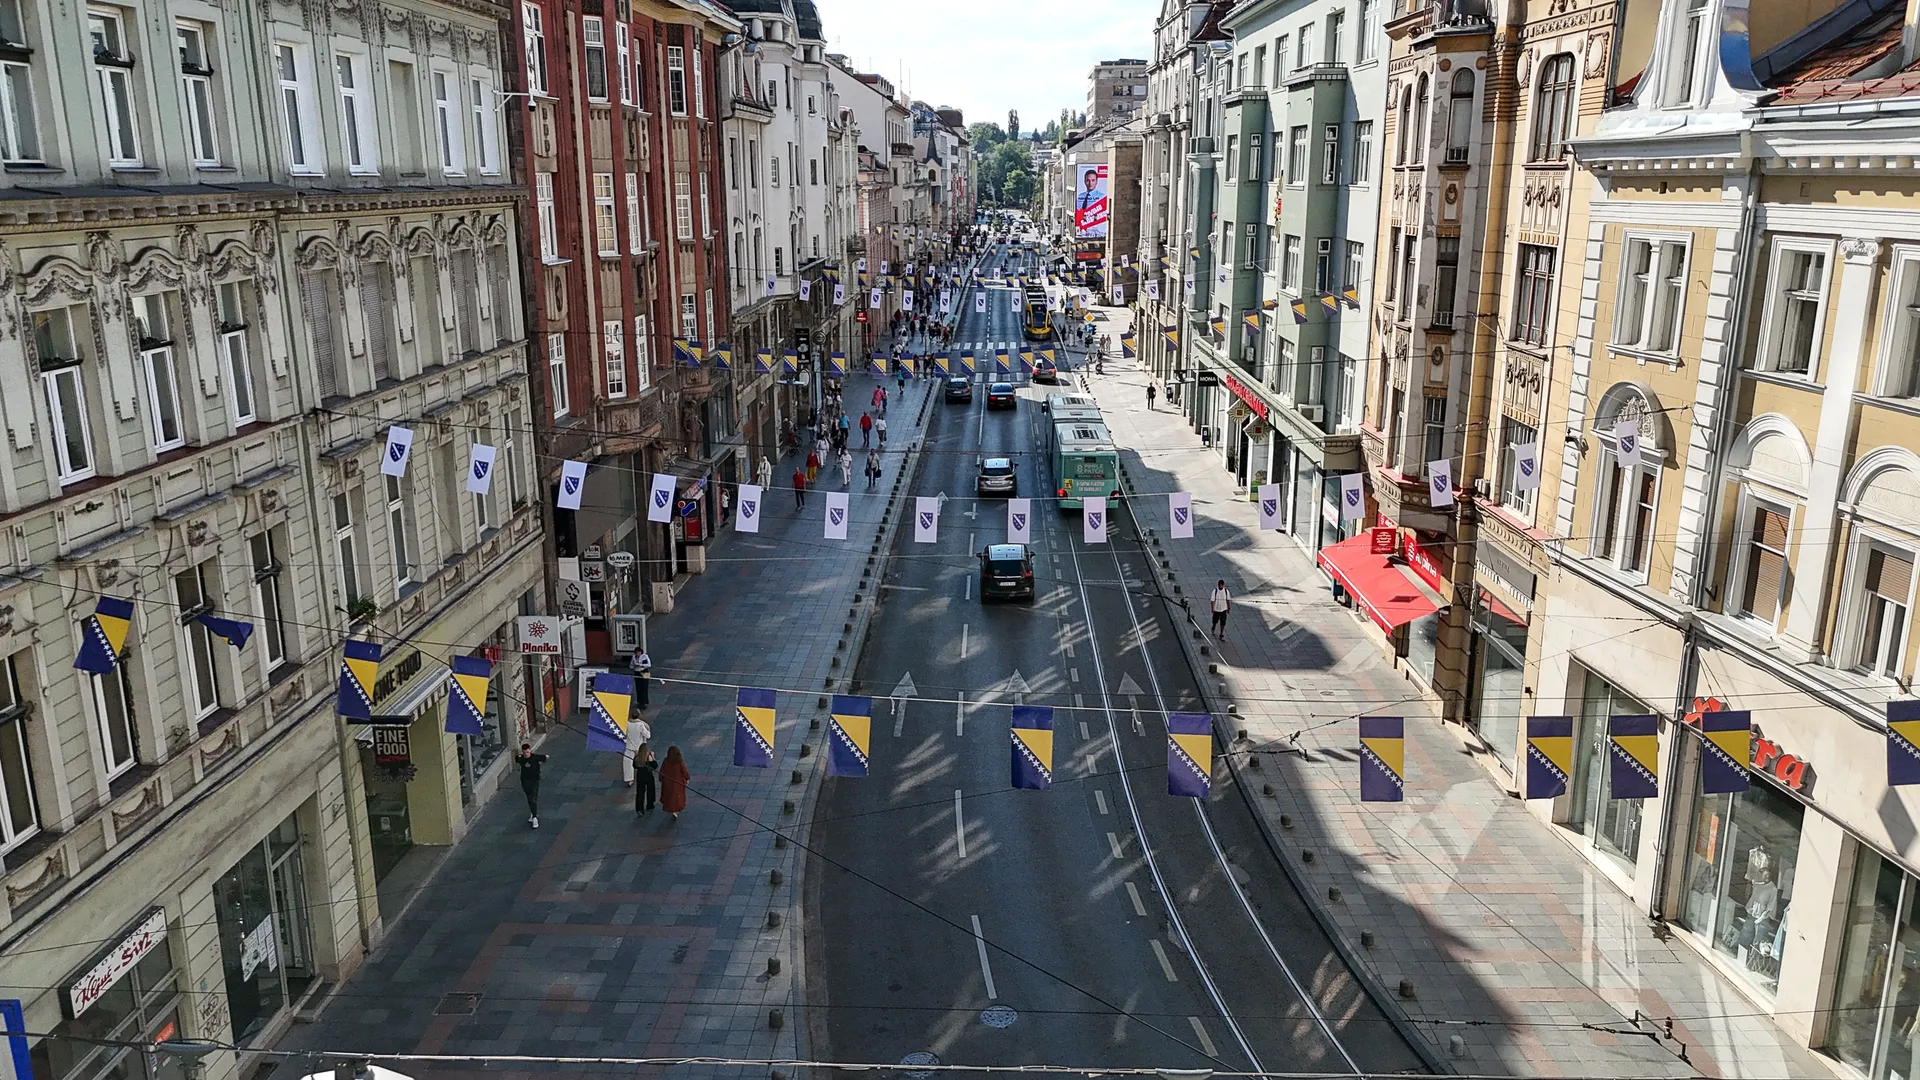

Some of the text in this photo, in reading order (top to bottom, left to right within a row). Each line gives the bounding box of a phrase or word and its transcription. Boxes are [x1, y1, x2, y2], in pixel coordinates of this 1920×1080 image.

[522, 642, 558, 652] Planika
[375, 729, 406, 742] FINE
[376, 742, 408, 755] FOOD
